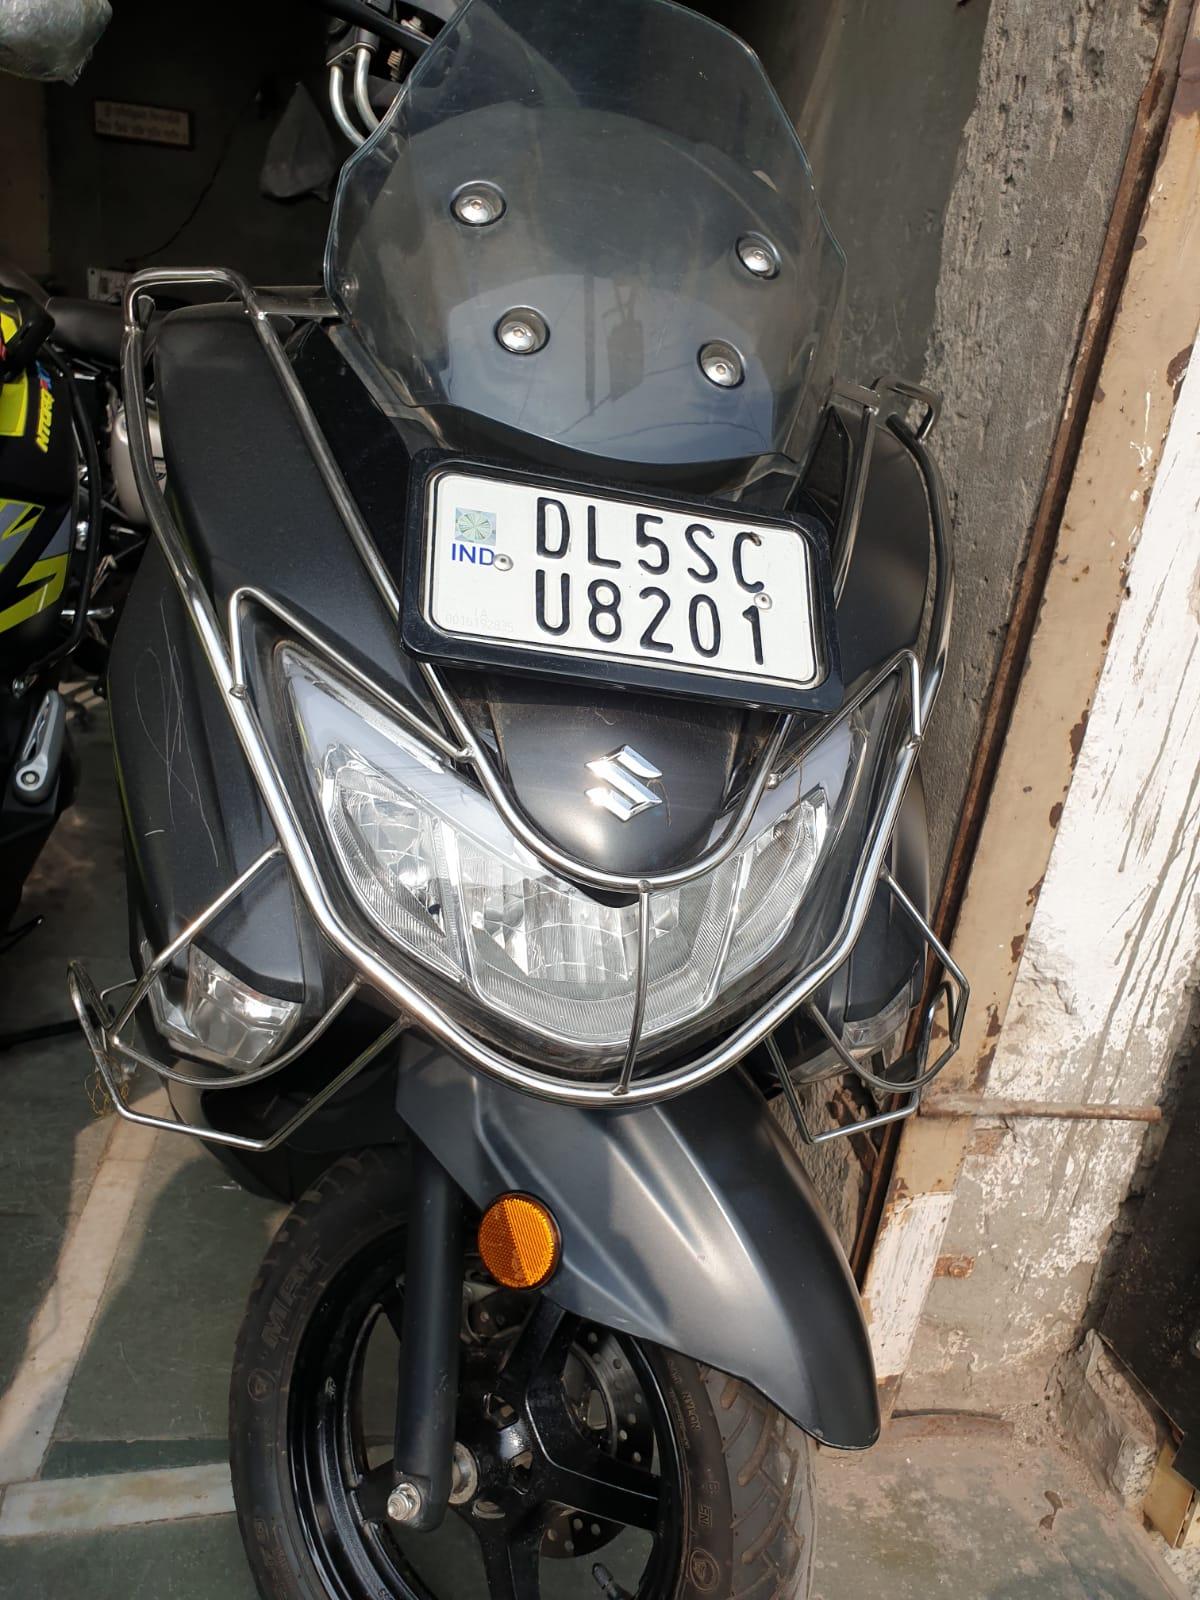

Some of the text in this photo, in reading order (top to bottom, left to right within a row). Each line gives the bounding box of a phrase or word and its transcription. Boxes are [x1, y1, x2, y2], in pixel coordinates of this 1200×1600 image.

[452, 543, 495, 566] IND
[536, 496, 764, 593] DL5SC
[535, 569, 765, 665] U8201
